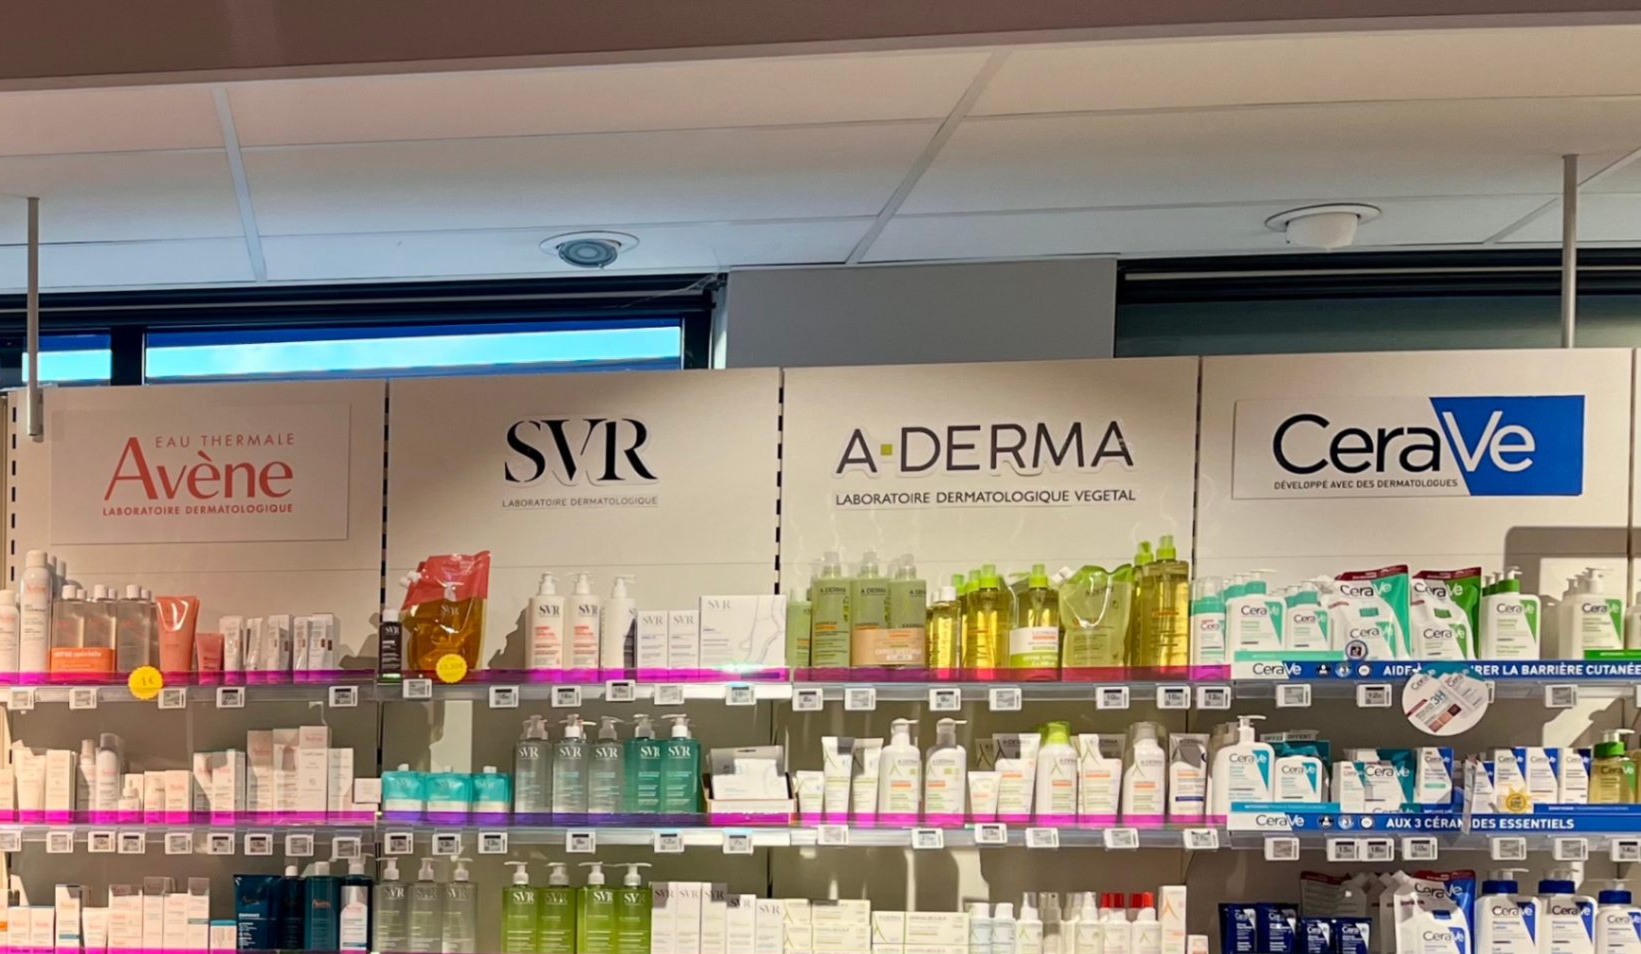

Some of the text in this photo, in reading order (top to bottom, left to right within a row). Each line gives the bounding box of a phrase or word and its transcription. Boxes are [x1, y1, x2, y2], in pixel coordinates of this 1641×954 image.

[155, 433, 294, 448] EAU THERMALE
[1272, 410, 1536, 475] CeraVe
[505, 418, 658, 482] SVR
[103, 437, 293, 500] Avène
[1274, 478, 1458, 490] DÉVELOPPÉ AVEC DES DERMATOLOGUES
[502, 496, 657, 507] LABORATOIRE DERMATOLOGIQUE
[836, 489, 1136, 505] LABORATOIRE DERMATOLOGIQUE VEGETAL
[102, 504, 293, 516] LABORATOIRE DERMATOLOGIQUE
[1253, 662, 1302, 676] CeraVe
[1500, 664, 1518, 676] LA
[1520, 661, 1583, 676] BARRIÈRE
[1255, 814, 1305, 828] CeraVe
[1386, 818, 1411, 829] AUX
[1414, 818, 1421, 829] 3
[1498, 818, 1575, 829] ESSENTIELS
